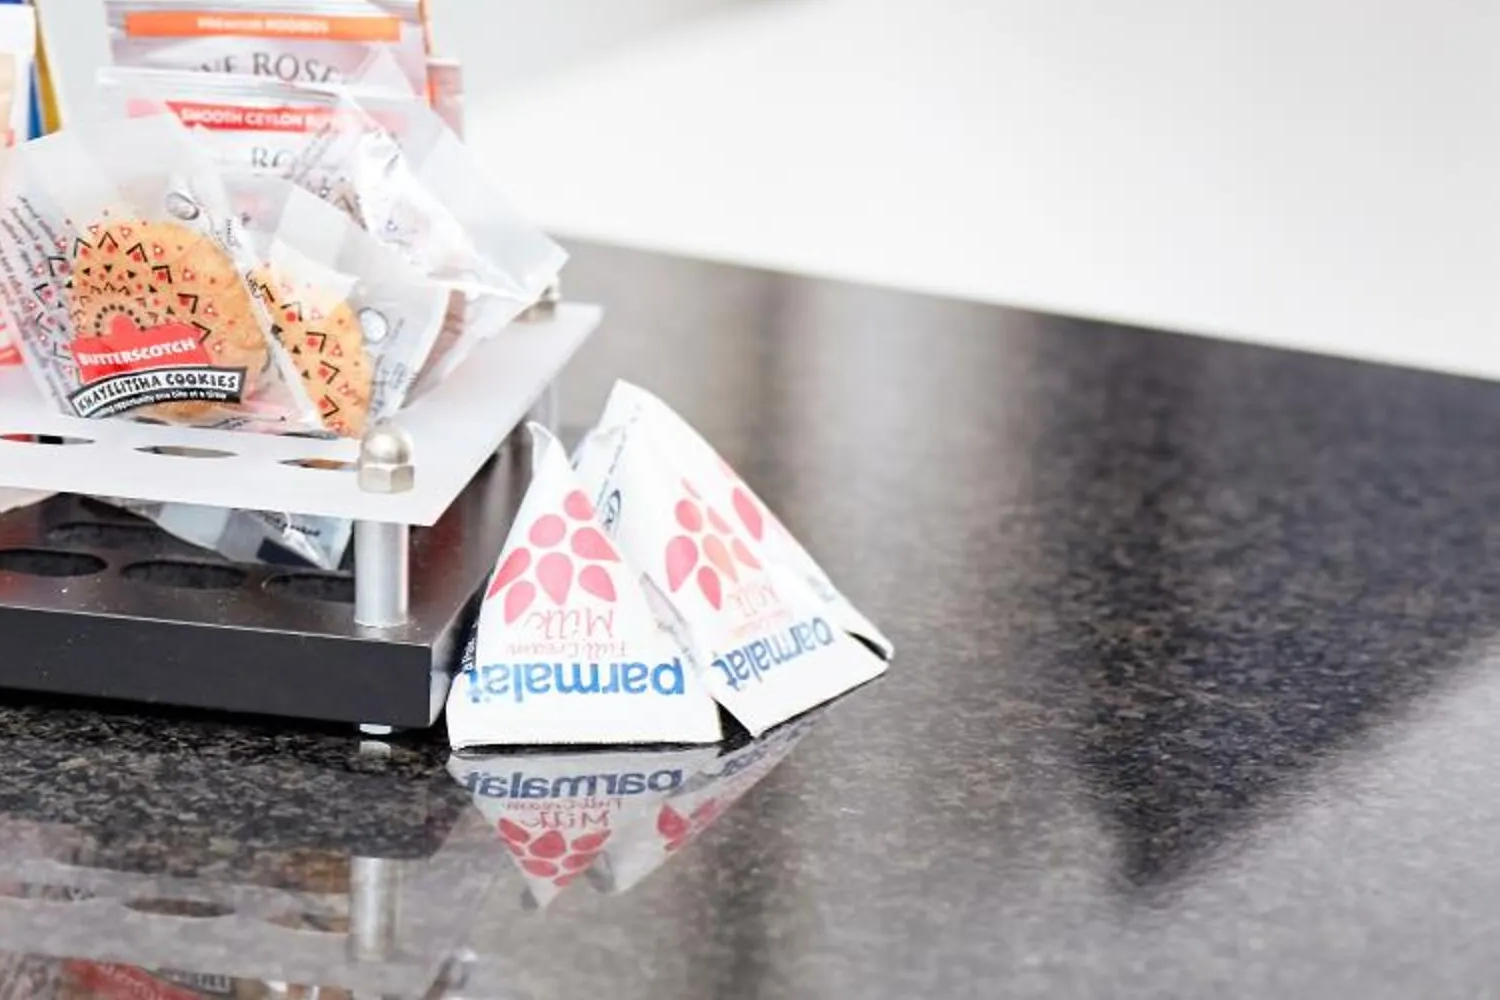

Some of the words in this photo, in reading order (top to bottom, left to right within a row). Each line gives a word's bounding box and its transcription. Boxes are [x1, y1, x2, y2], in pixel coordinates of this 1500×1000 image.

[78, 337, 197, 366] BUTTERSCOTCH
[78, 375, 164, 411] KHAYELITSHA
[165, 372, 238, 390] COOKIES
[526, 607, 614, 641] Milk
[711, 616, 835, 691] parmalat
[465, 658, 685, 704] parmalat
